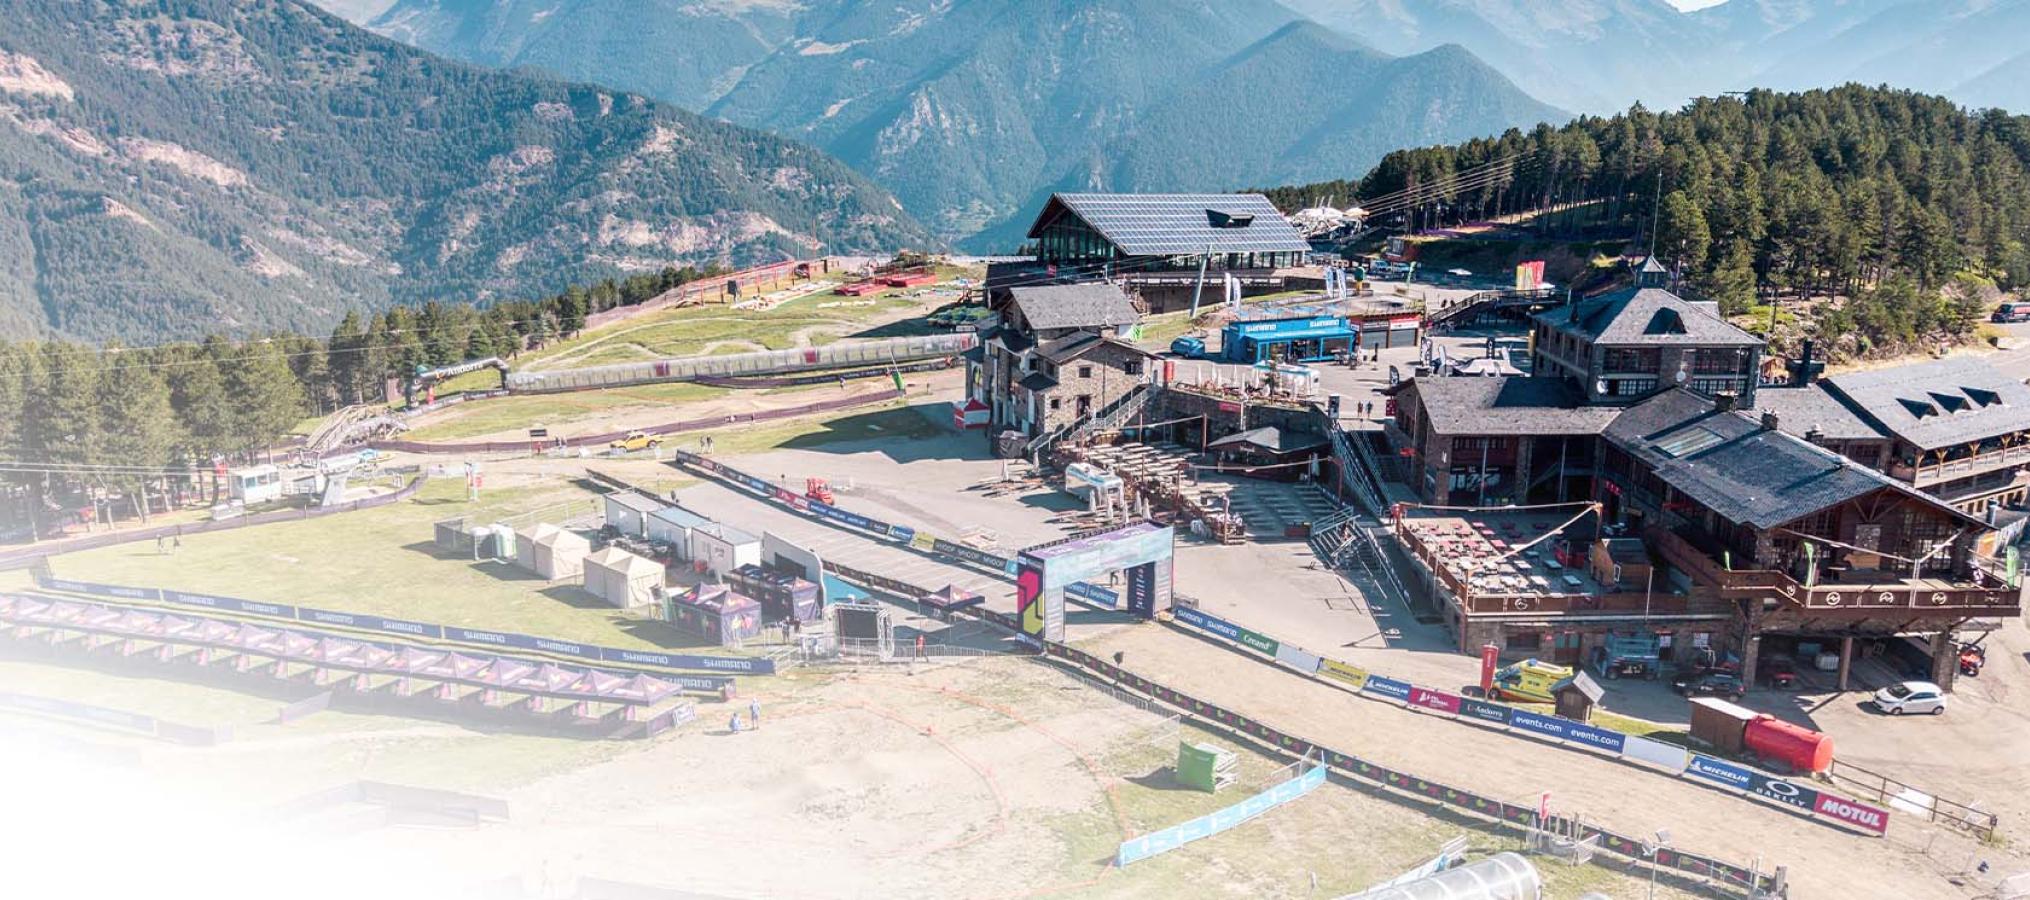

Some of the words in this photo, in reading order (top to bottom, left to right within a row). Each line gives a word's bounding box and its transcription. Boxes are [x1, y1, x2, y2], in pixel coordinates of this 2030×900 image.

[622, 652, 668, 664] SHIMANO
[704, 659, 751, 670] SHIMANO
[1515, 717, 1562, 732] events.com
[1571, 729, 1620, 746] events.com
[1703, 765, 1749, 783] MICHELIN
[1756, 787, 1805, 807] OAKLEY
[1822, 799, 1881, 826] MOTUL
